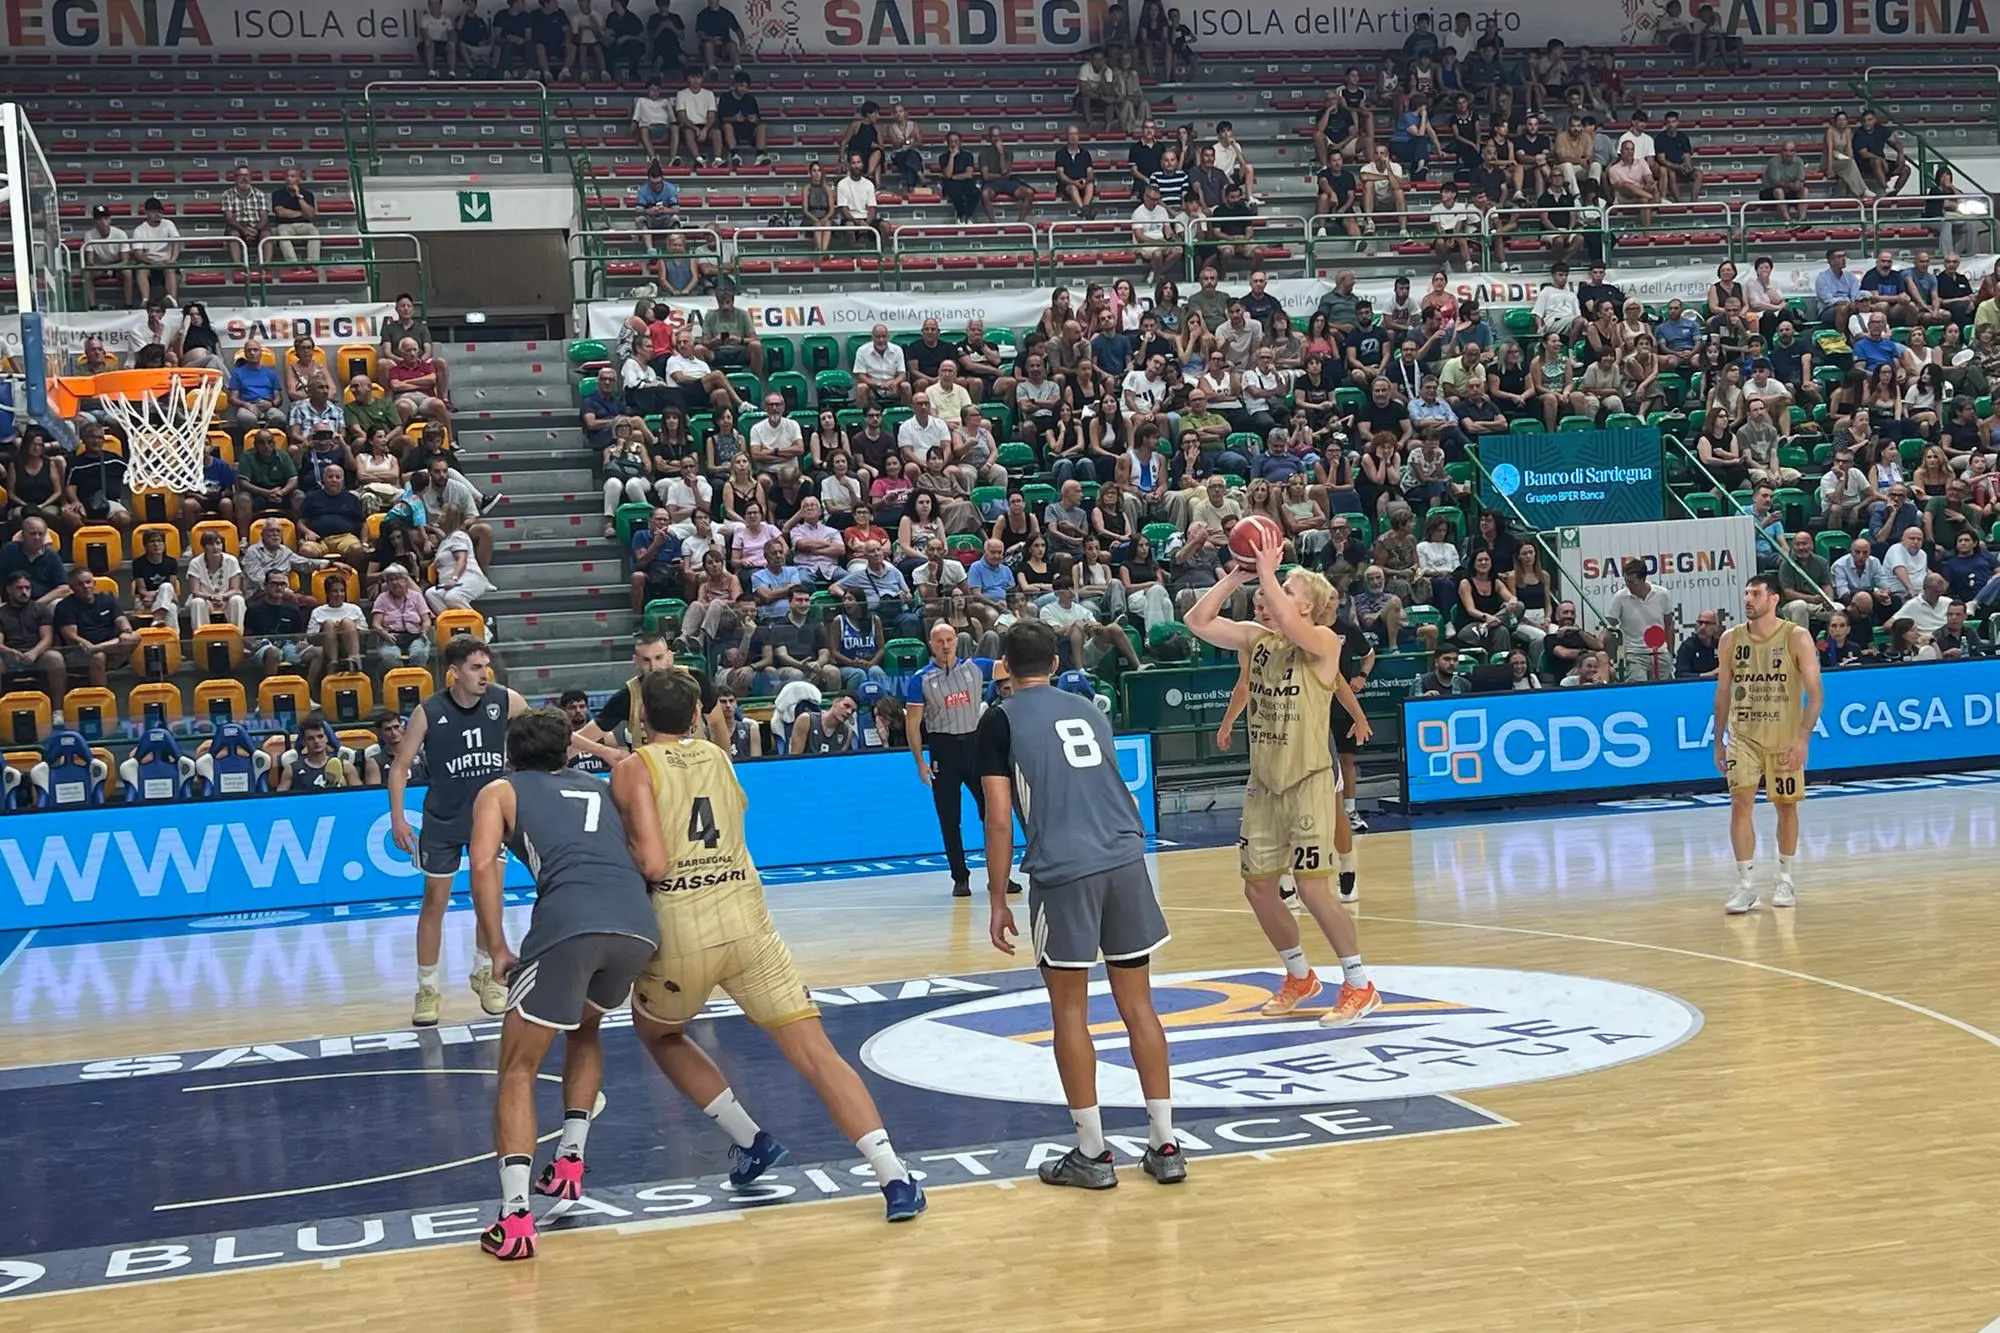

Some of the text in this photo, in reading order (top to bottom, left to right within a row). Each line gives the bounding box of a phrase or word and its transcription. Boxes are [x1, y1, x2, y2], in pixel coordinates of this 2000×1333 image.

[234, 9, 345, 39] ISOLA
[1193, 9, 1285, 36] ISOLA
[670, 305, 986, 329] SAEGNA ISOLA dell'Artigianato
[1524, 465, 1652, 487] Banco di Sardegna
[1525, 490, 1605, 504] Gruppo BPER Banca
[1585, 574, 1737, 596] sardturismo.it
[843, 636, 876, 649] ITALIA
[1735, 645, 1750, 661] 30
[1253, 643, 1271, 668] 25
[462, 727, 483, 749] 11
[1054, 718, 1104, 769] 8
[1494, 711, 1651, 776] CDS
[1840, 696, 1953, 736] CASA
[446, 751, 503, 775] VIRTUS
[1775, 777, 1796, 795] 30
[560, 789, 602, 832] 7
[688, 797, 721, 849] 4
[677, 856, 733, 868] SARDEGNA
[1294, 845, 1320, 871] 25
[659, 869, 746, 892] SASSARI
[1175, 1018, 1603, 1089] REALE
[1236, 1032, 1654, 1101] MUTUA
[105, 1206, 485, 1279] BLUE
